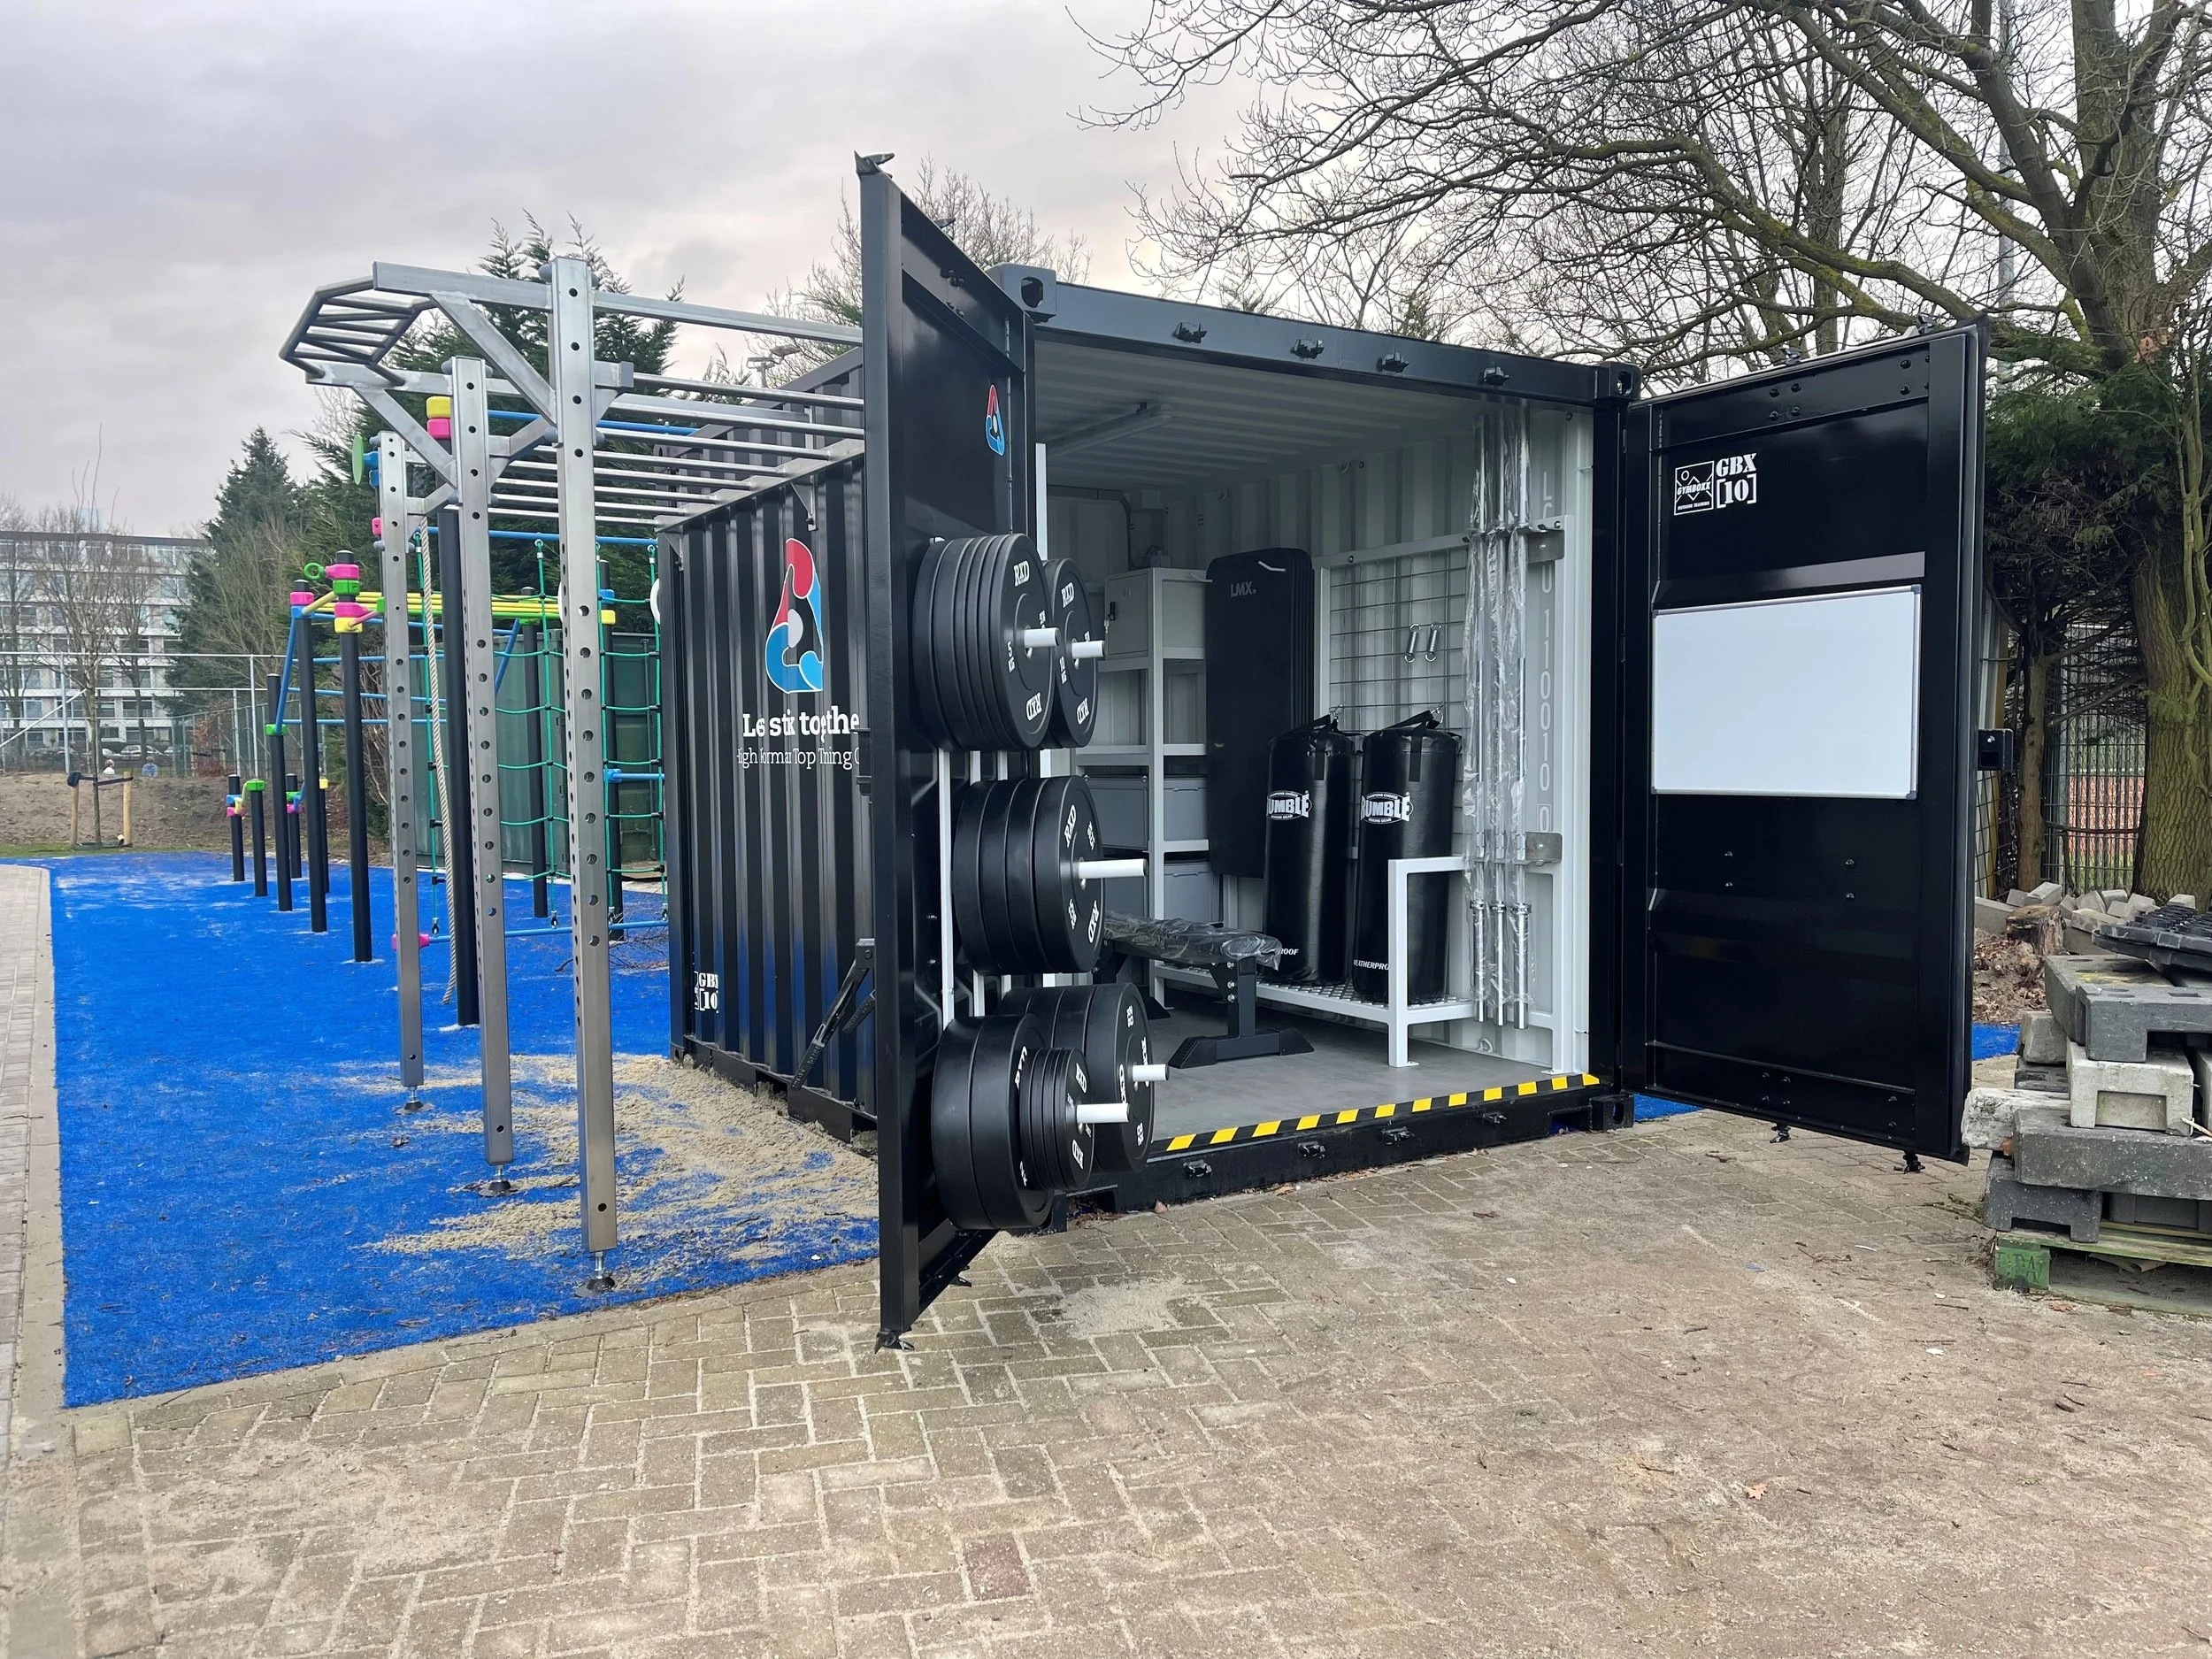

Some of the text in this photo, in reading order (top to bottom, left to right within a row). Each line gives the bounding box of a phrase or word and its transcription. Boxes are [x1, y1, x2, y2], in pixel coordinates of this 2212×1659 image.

[1716, 452, 1757, 478] GBX
[1677, 480, 1711, 496] GYMBOXX
[1013, 560, 1030, 587] RXD
[1061, 581, 1075, 608] RXD
[1007, 641, 1013, 657] 5
[1026, 692, 1042, 721] RXD
[1077, 697, 1089, 725] RXD
[793, 748, 816, 770] Top
[1266, 793, 1310, 818] UMBLE
[1360, 795, 1410, 822] RUMBLE
[1064, 804, 1077, 848] RXD
[1088, 900, 1100, 943] RXD
